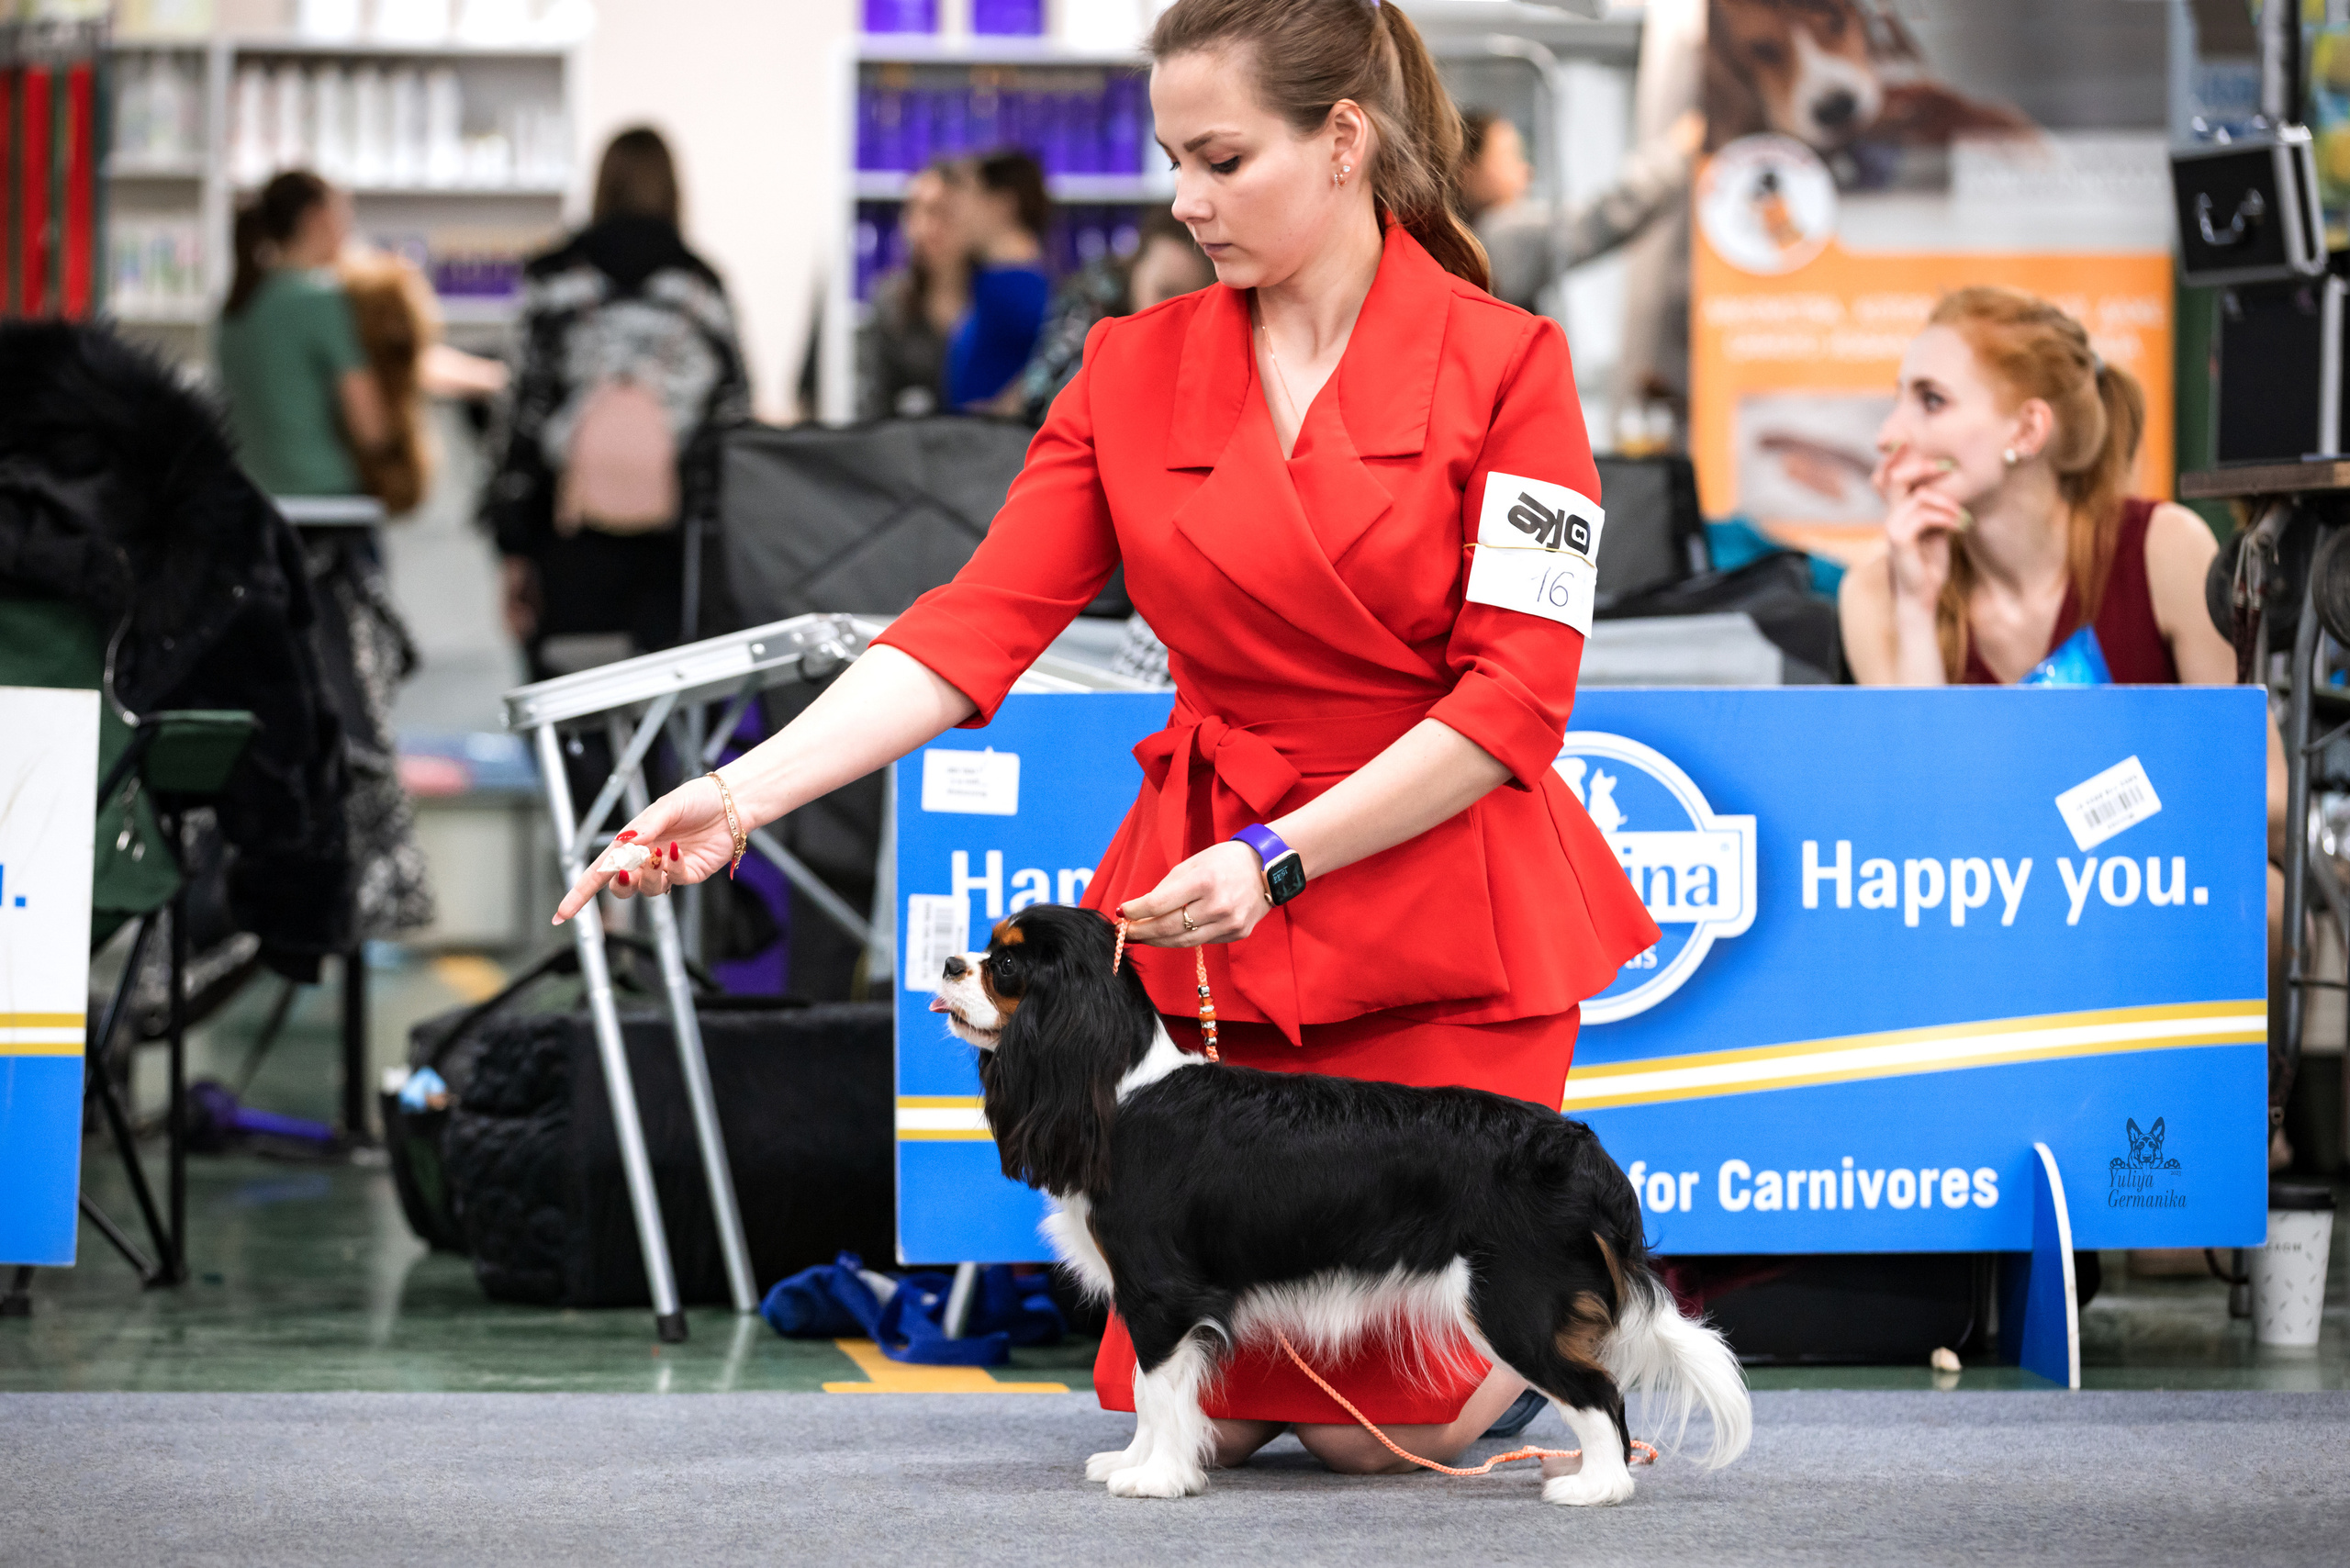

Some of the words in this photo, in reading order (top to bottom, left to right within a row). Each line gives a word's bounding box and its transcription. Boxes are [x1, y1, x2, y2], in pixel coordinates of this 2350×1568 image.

[1531, 566, 1575, 608] 16
[1802, 839, 2033, 927] Happy
[2056, 856, 2209, 926] you.
[1628, 1160, 1700, 1213] for
[1718, 1156, 1999, 1212] Carnivores
